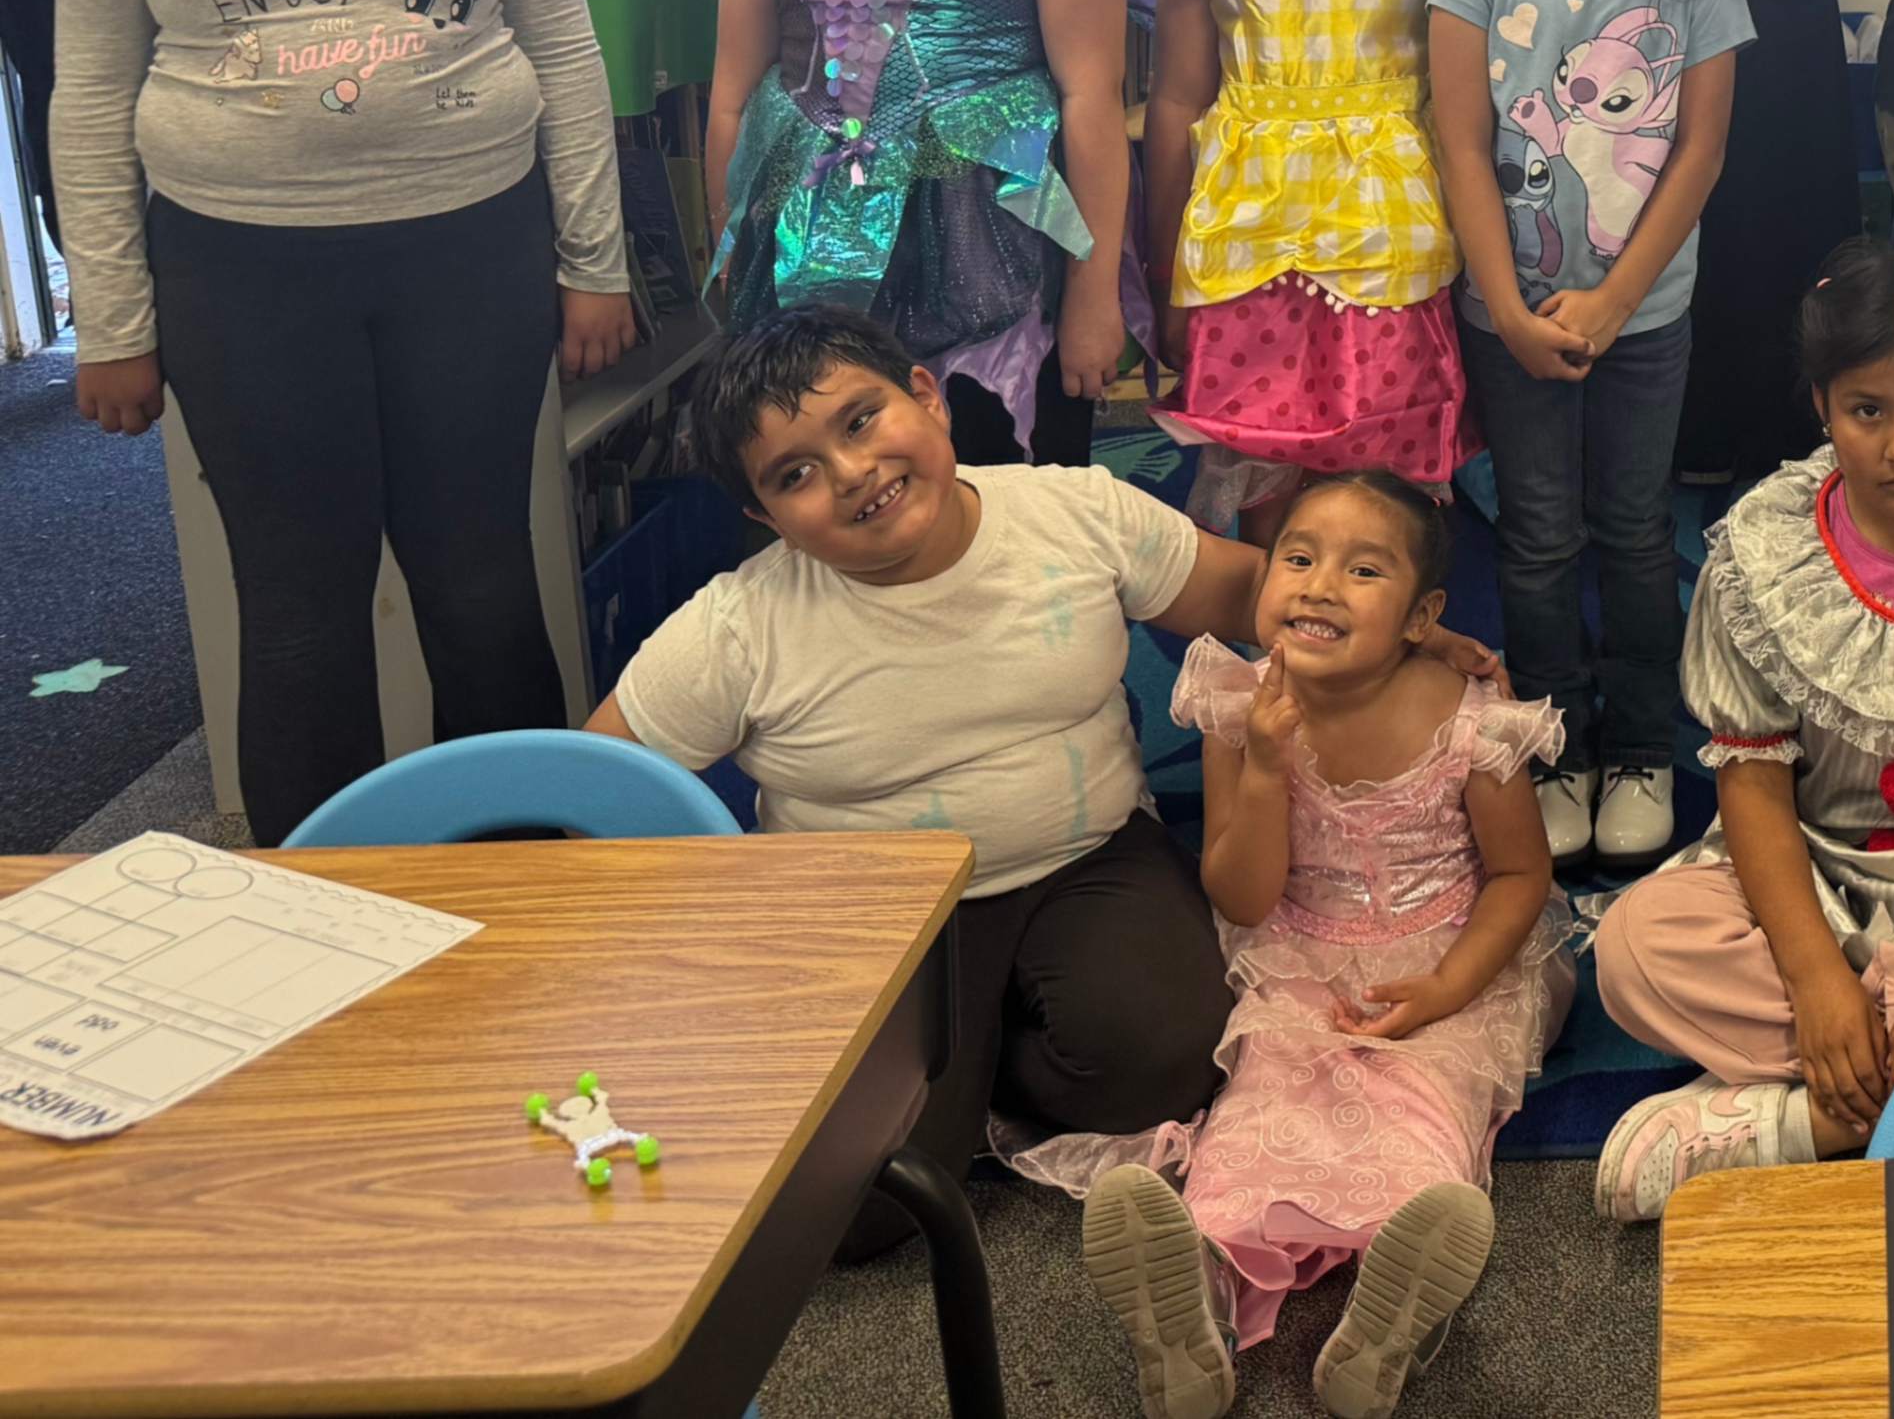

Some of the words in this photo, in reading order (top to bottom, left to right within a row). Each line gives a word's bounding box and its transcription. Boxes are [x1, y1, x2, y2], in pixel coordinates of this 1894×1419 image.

[277, 37, 364, 76] have
[359, 24, 426, 79] fun
[0, 1081, 123, 1126] NUMBER
